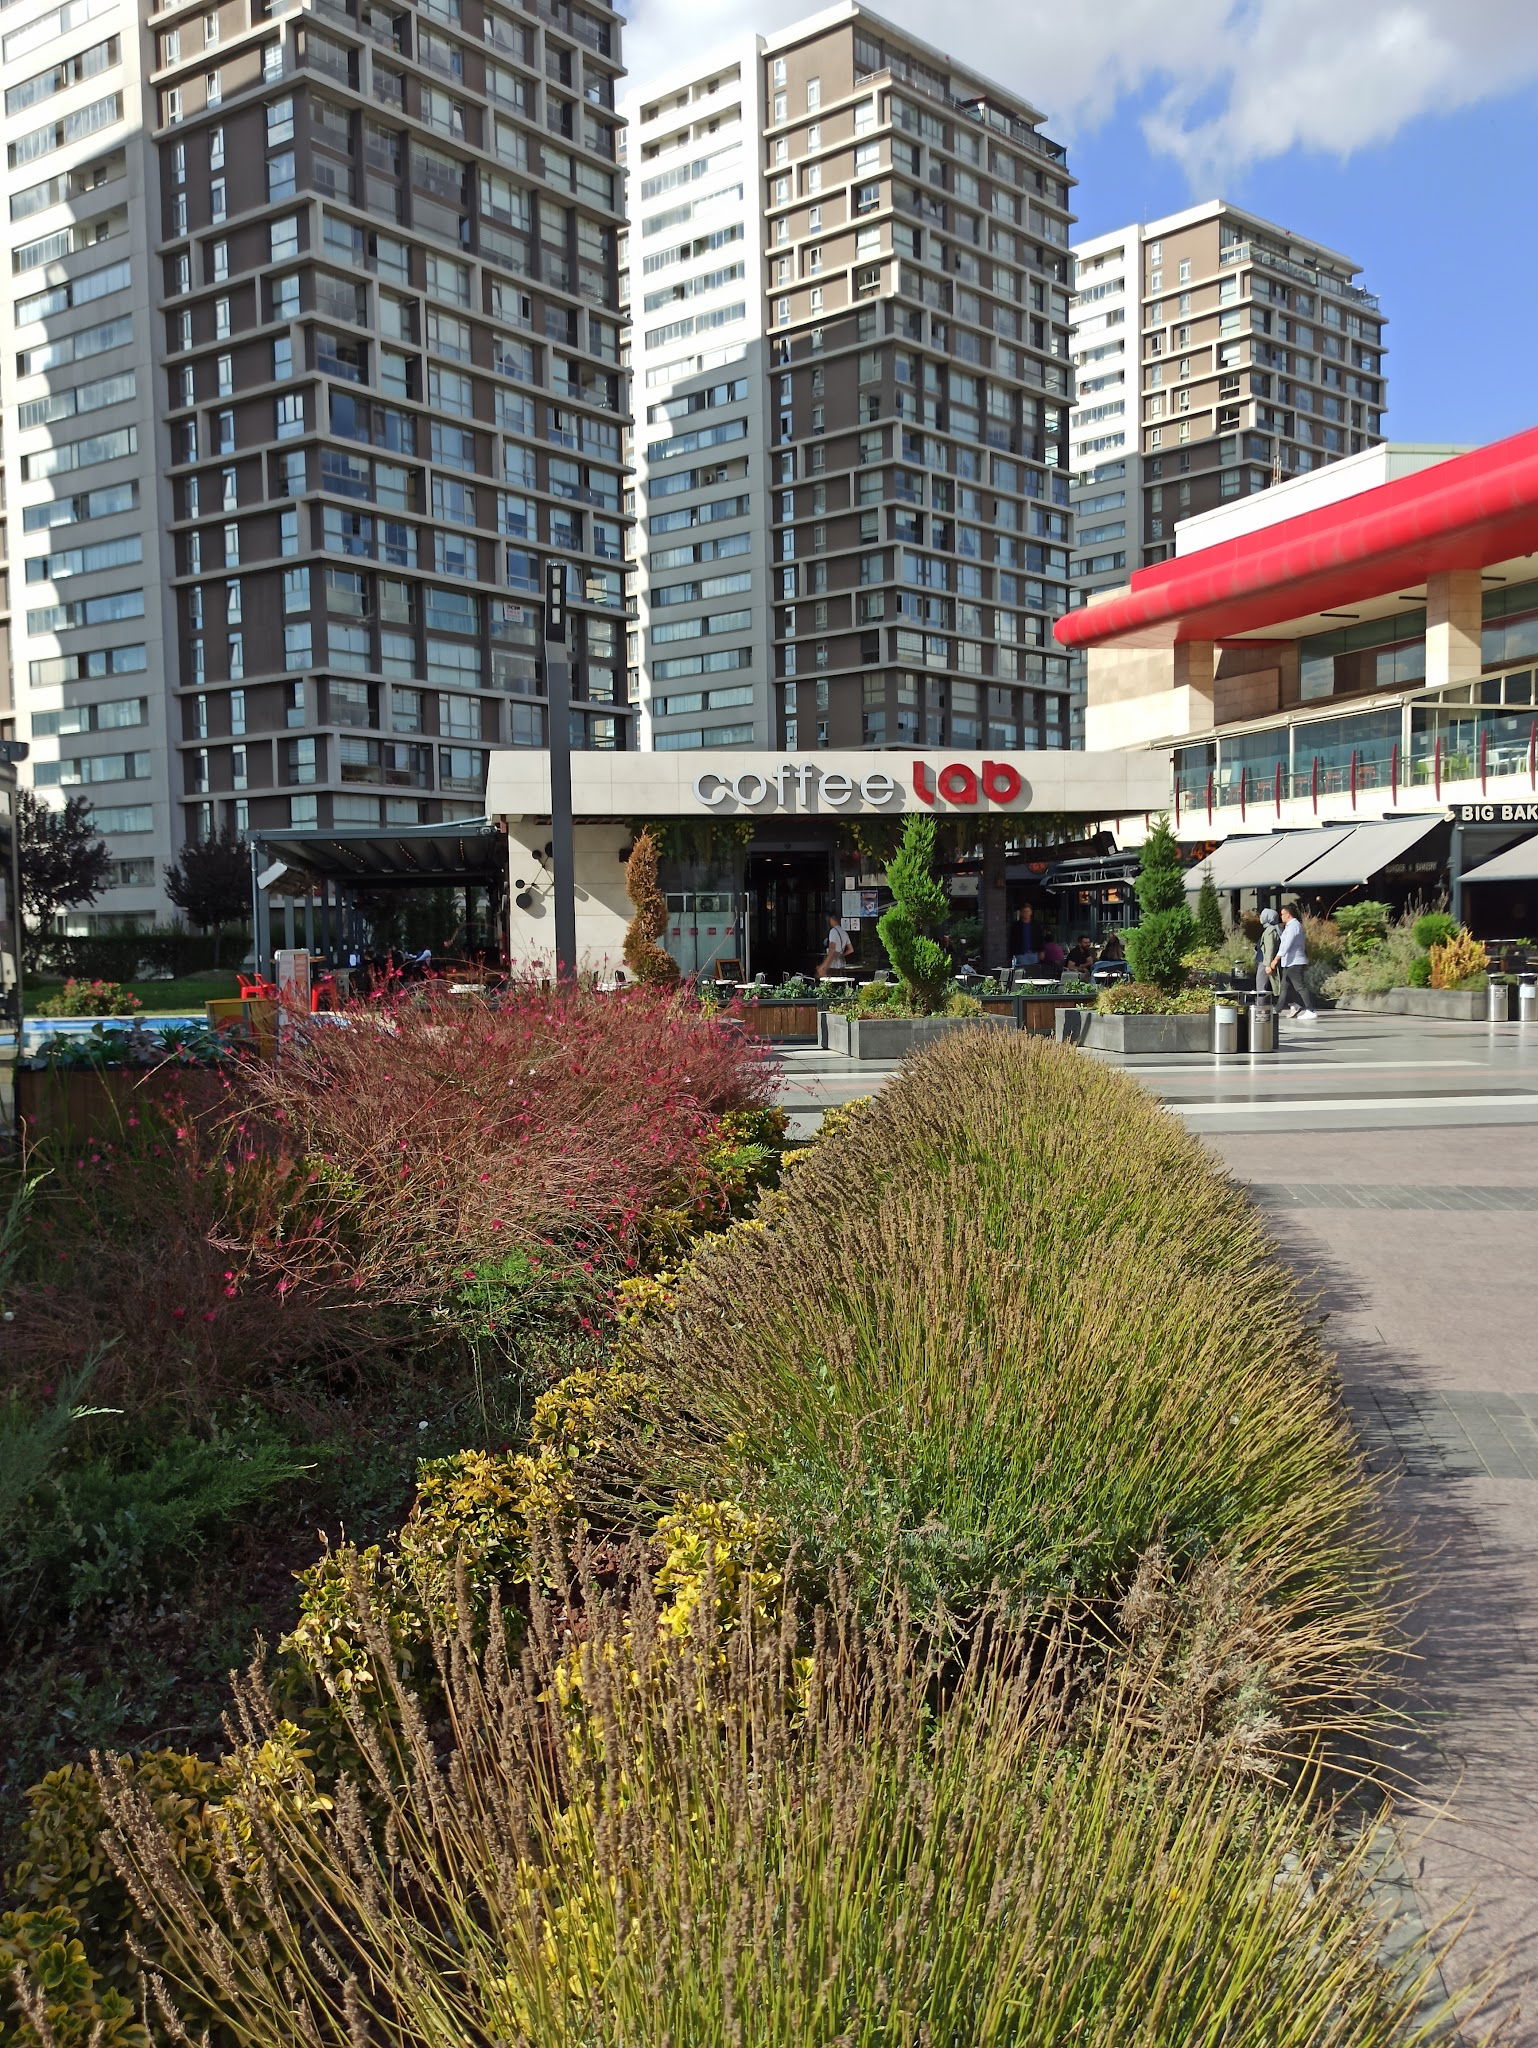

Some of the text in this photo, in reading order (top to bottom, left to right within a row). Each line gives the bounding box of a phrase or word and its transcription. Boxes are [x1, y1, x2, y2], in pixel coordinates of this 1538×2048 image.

[692, 760, 1021, 805] coffee lab
[1461, 804, 1538, 821] BIG BAK
